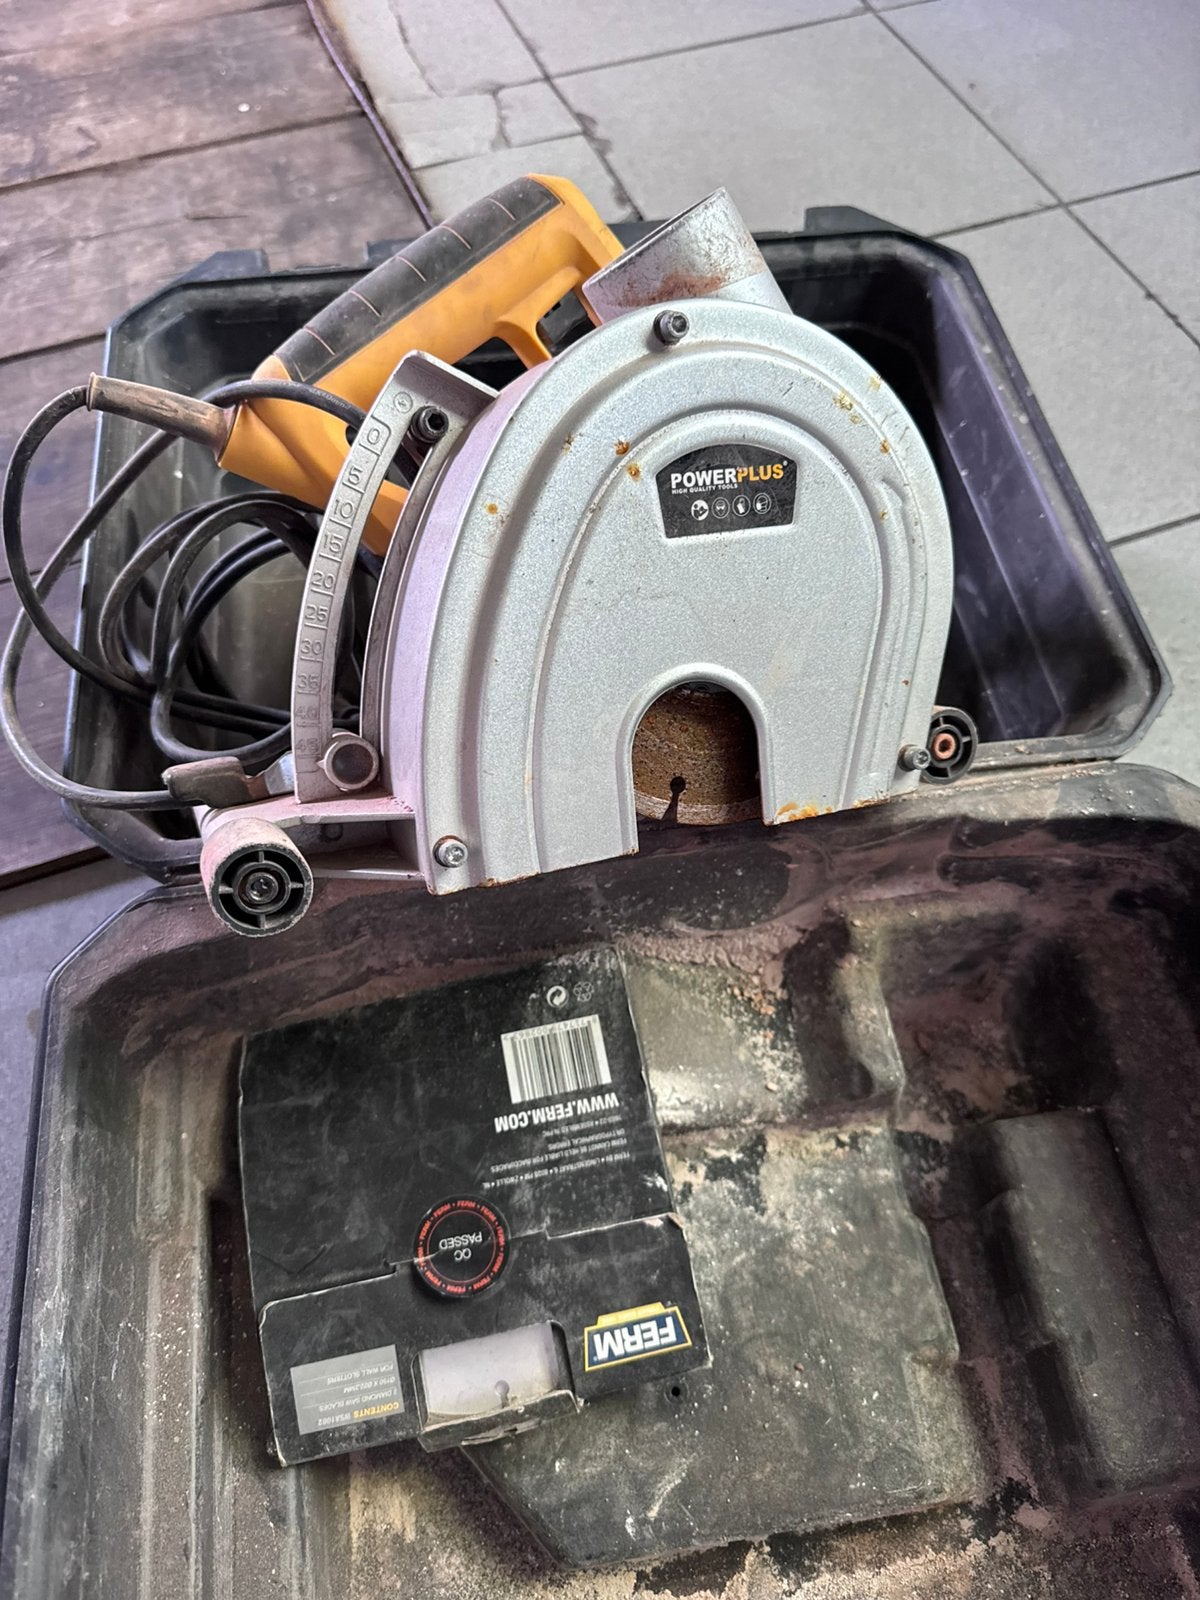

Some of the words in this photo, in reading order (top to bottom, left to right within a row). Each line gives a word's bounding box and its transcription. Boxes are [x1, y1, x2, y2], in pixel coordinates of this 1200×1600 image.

[367, 428, 381, 445] 0
[348, 467, 362, 486] 5
[670, 463, 784, 488] POWERPLUS
[689, 485, 716, 493] QUALITY
[334, 499, 354, 519] 10
[323, 533, 343, 553] 15
[312, 571, 335, 589] 20
[304, 605, 329, 622] 25
[300, 640, 322, 655] 30
[297, 674, 320, 690] 35
[493, 1092, 619, 1133] WWW.FERM.COM
[439, 1232, 482, 1250] PASSED
[453, 1248, 472, 1261] QC
[592, 1317, 676, 1360] FERM
[345, 1397, 360, 1405] SAW
[361, 1389, 392, 1402] DIAMOND
[318, 1400, 344, 1411] BLADES
[352, 1401, 399, 1418] CONTENTS
